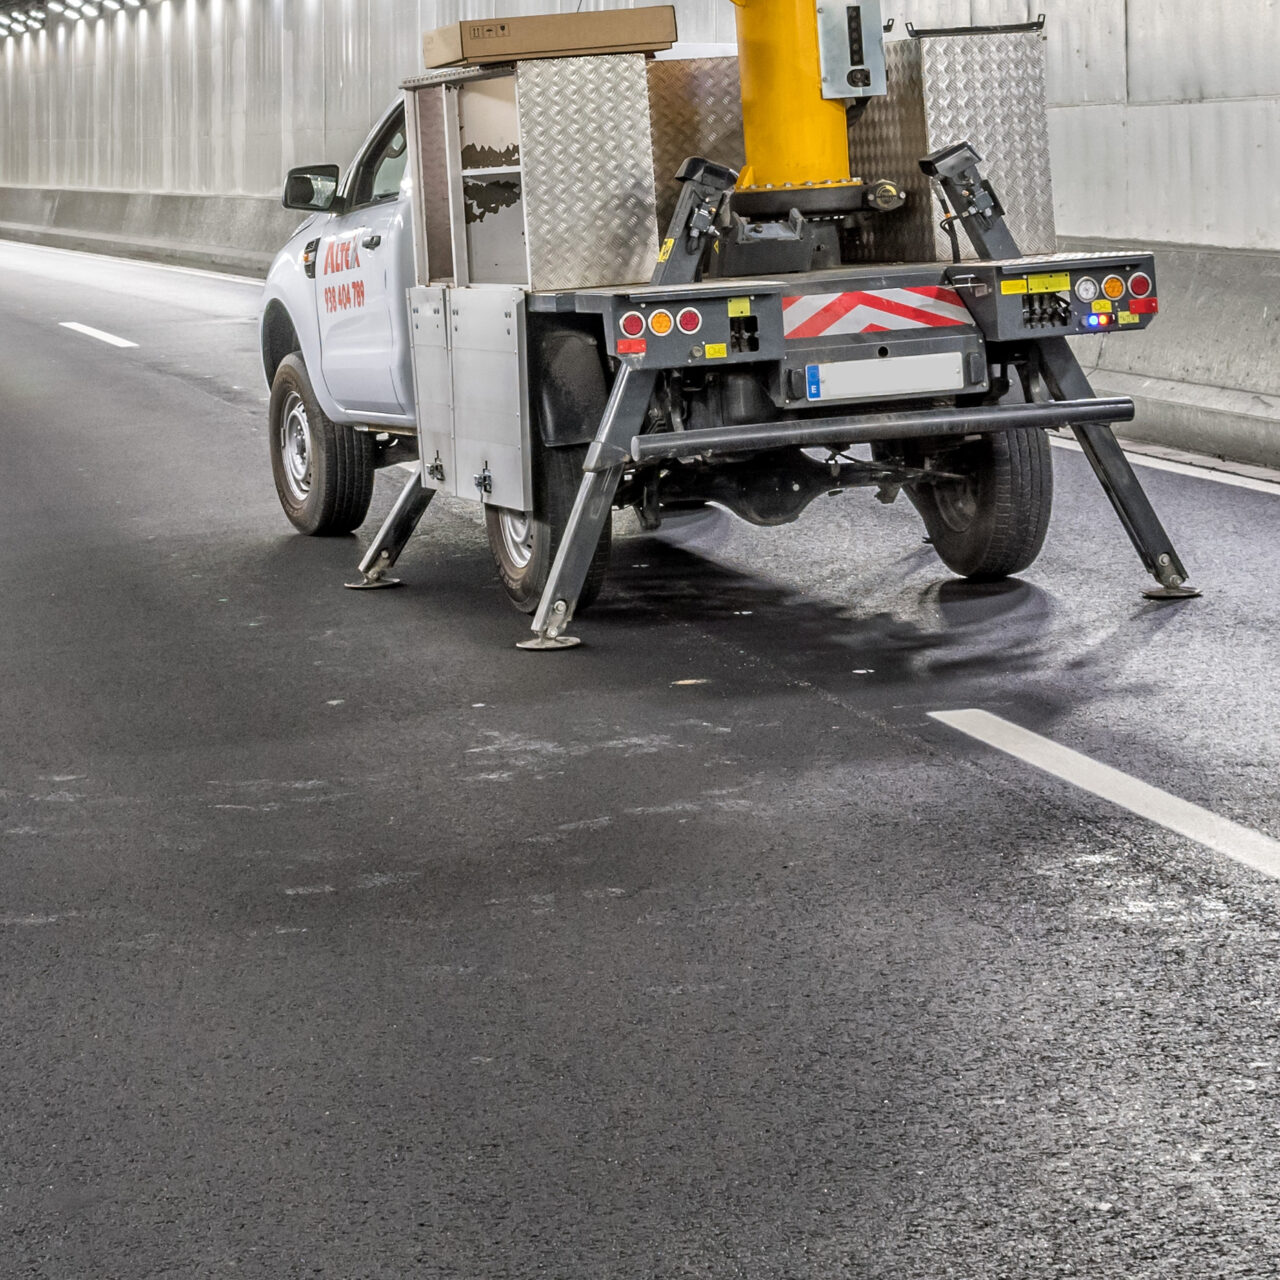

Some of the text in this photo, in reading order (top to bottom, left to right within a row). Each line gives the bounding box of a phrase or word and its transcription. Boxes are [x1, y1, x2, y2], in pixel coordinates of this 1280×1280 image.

[324, 280, 365, 313] 938 404 789
[811, 385, 817, 394] E
